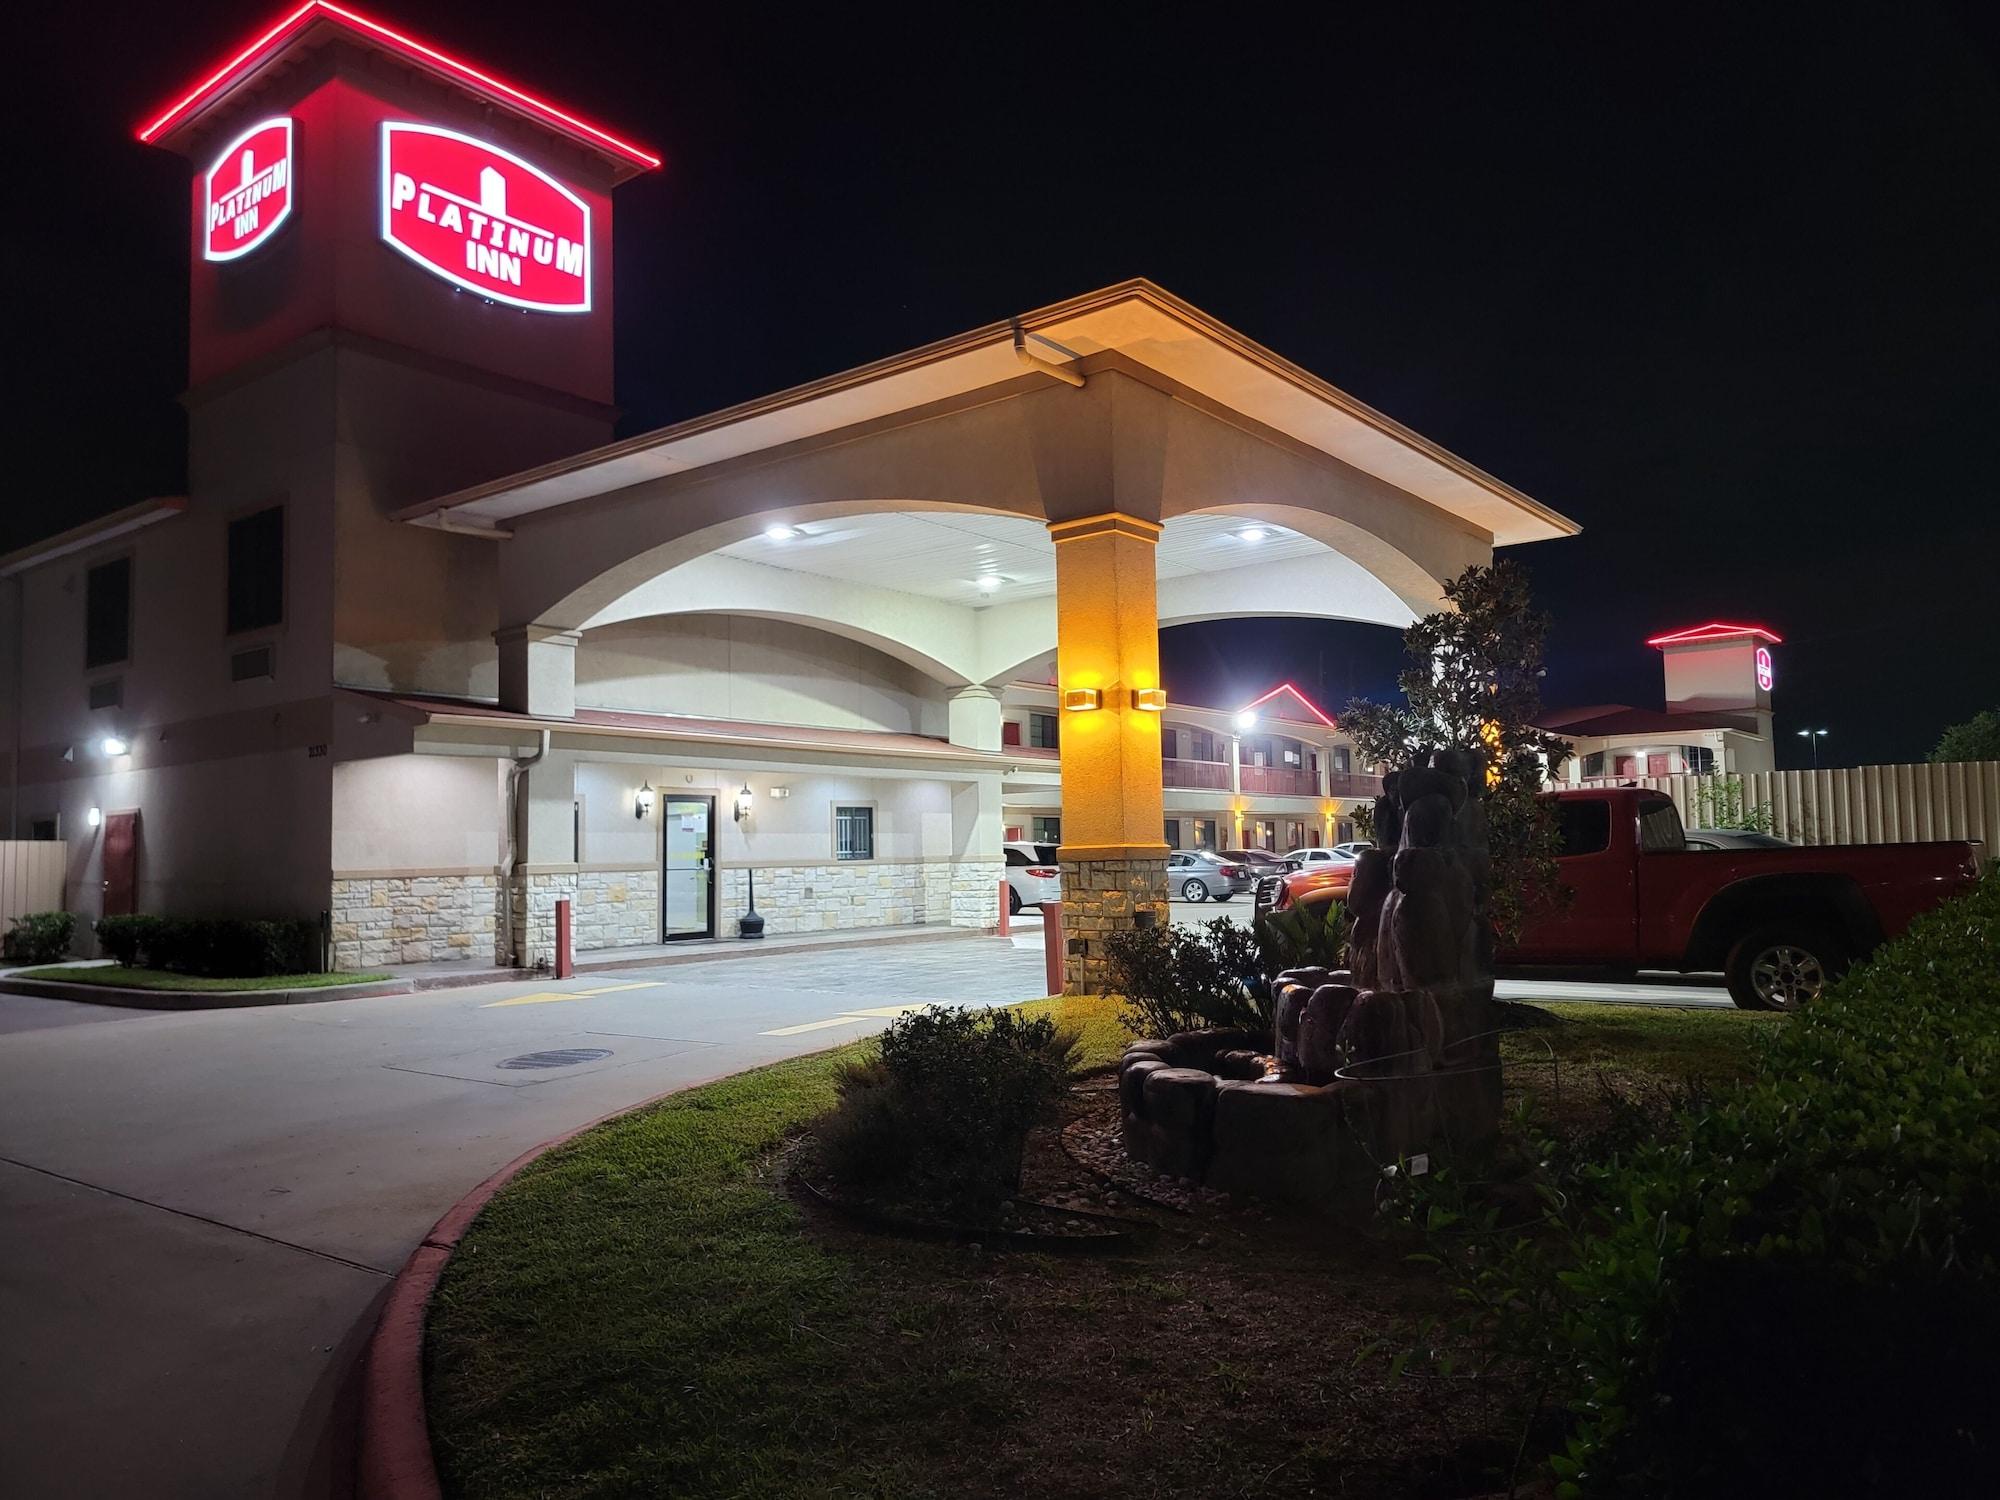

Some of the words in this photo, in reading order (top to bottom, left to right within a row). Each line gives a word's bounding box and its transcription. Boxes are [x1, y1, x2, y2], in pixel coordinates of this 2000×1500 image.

[211, 157, 286, 232] PLATINUM
[234, 205, 258, 239] INN
[392, 172, 583, 277] PLATINUM
[466, 240, 521, 286] INN
